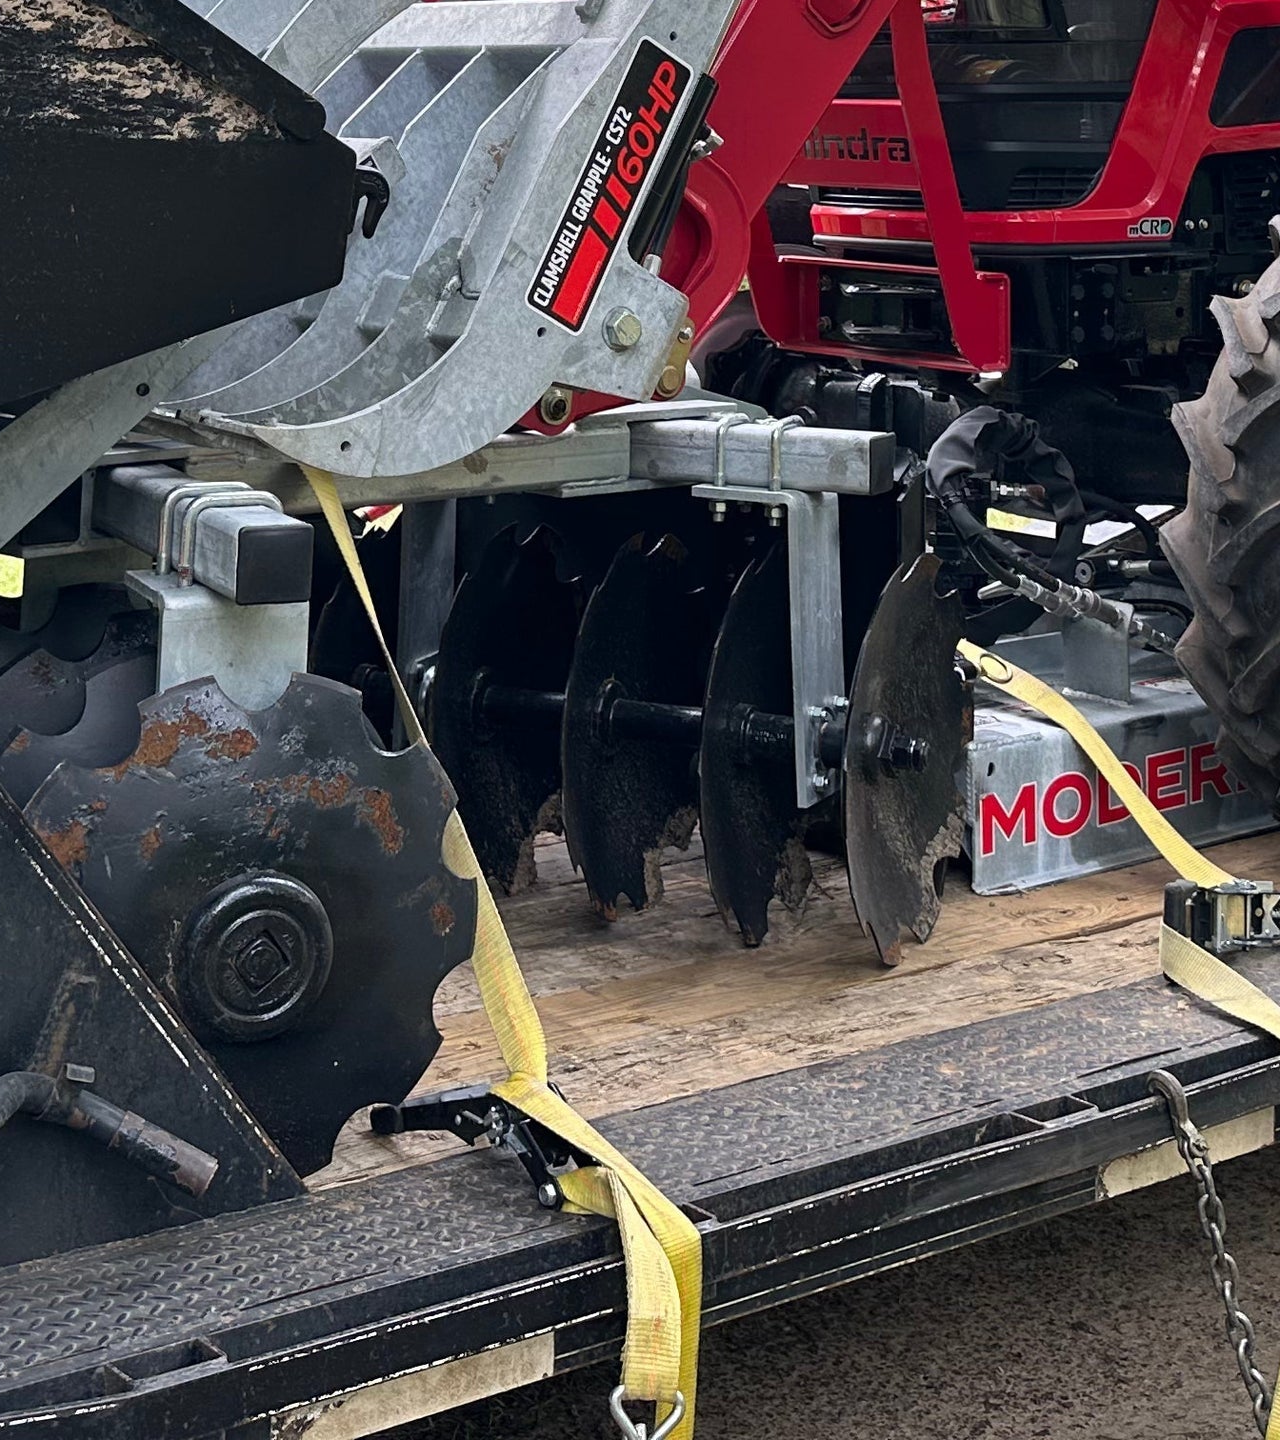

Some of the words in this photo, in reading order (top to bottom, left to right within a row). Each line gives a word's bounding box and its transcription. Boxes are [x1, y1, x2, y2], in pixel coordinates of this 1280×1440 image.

[805, 127, 911, 162] indra
[532, 220, 583, 308] CLAMSHELL
[571, 150, 613, 222] GRAPPLE
[604, 105, 633, 146] CS72
[978, 741, 1248, 858] MODER
